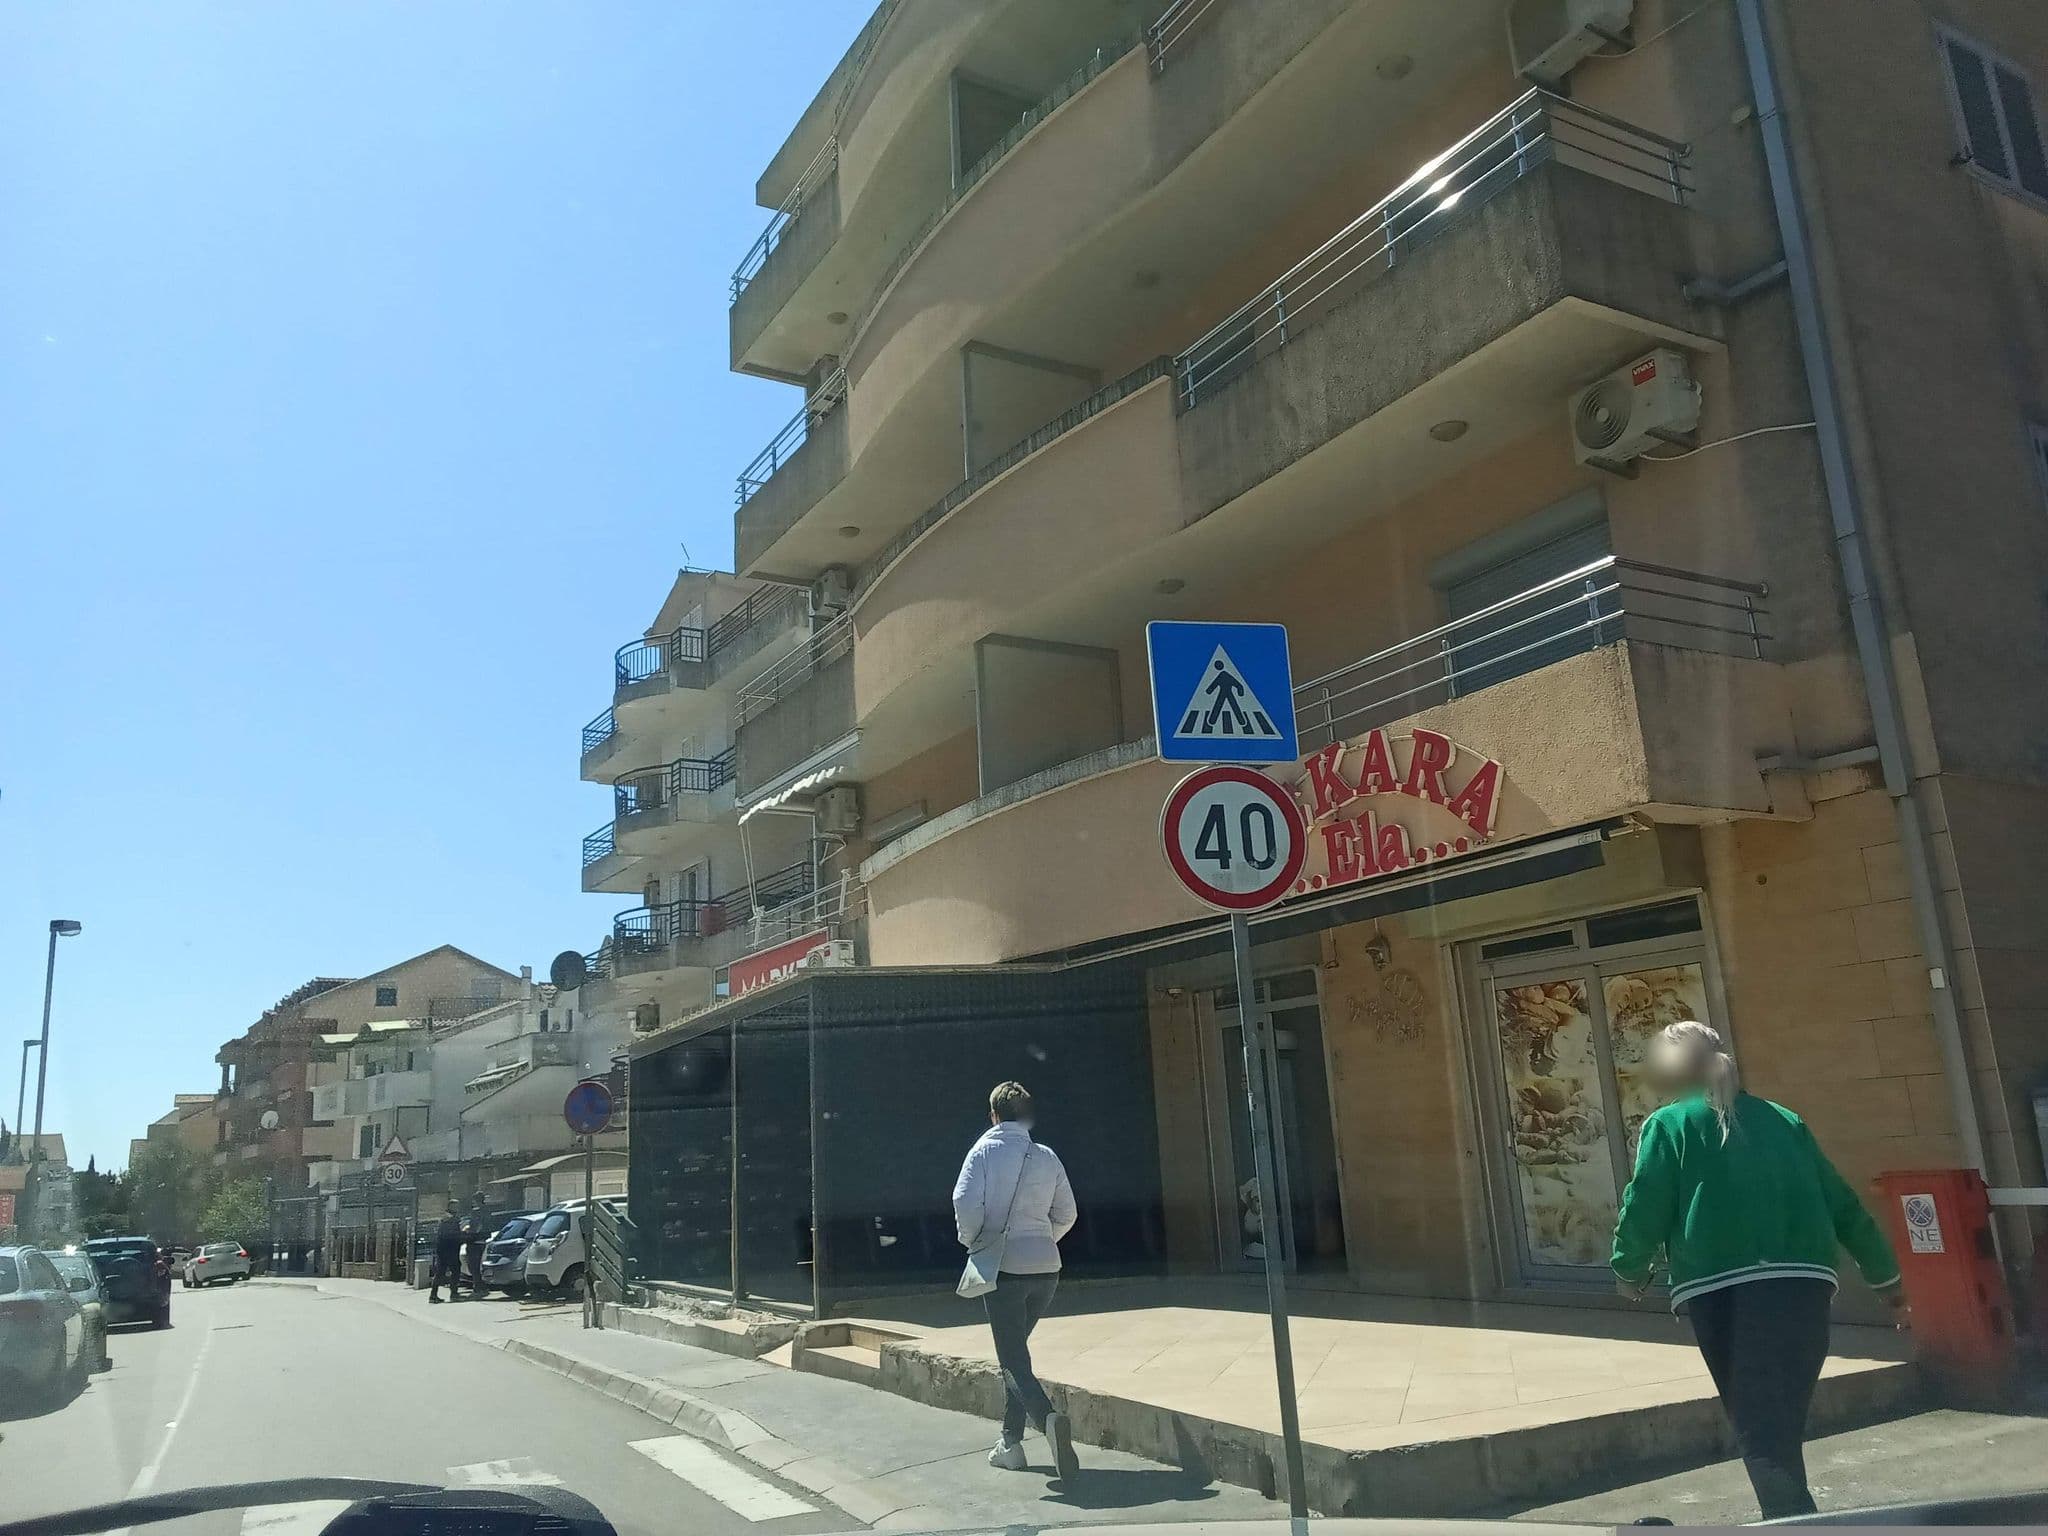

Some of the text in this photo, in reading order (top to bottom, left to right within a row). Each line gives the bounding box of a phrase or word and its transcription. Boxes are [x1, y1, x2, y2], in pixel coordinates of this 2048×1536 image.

[1195, 802, 1277, 871] 40
[387, 1168, 403, 1180] 30
[1910, 1228, 1940, 1242] NE
